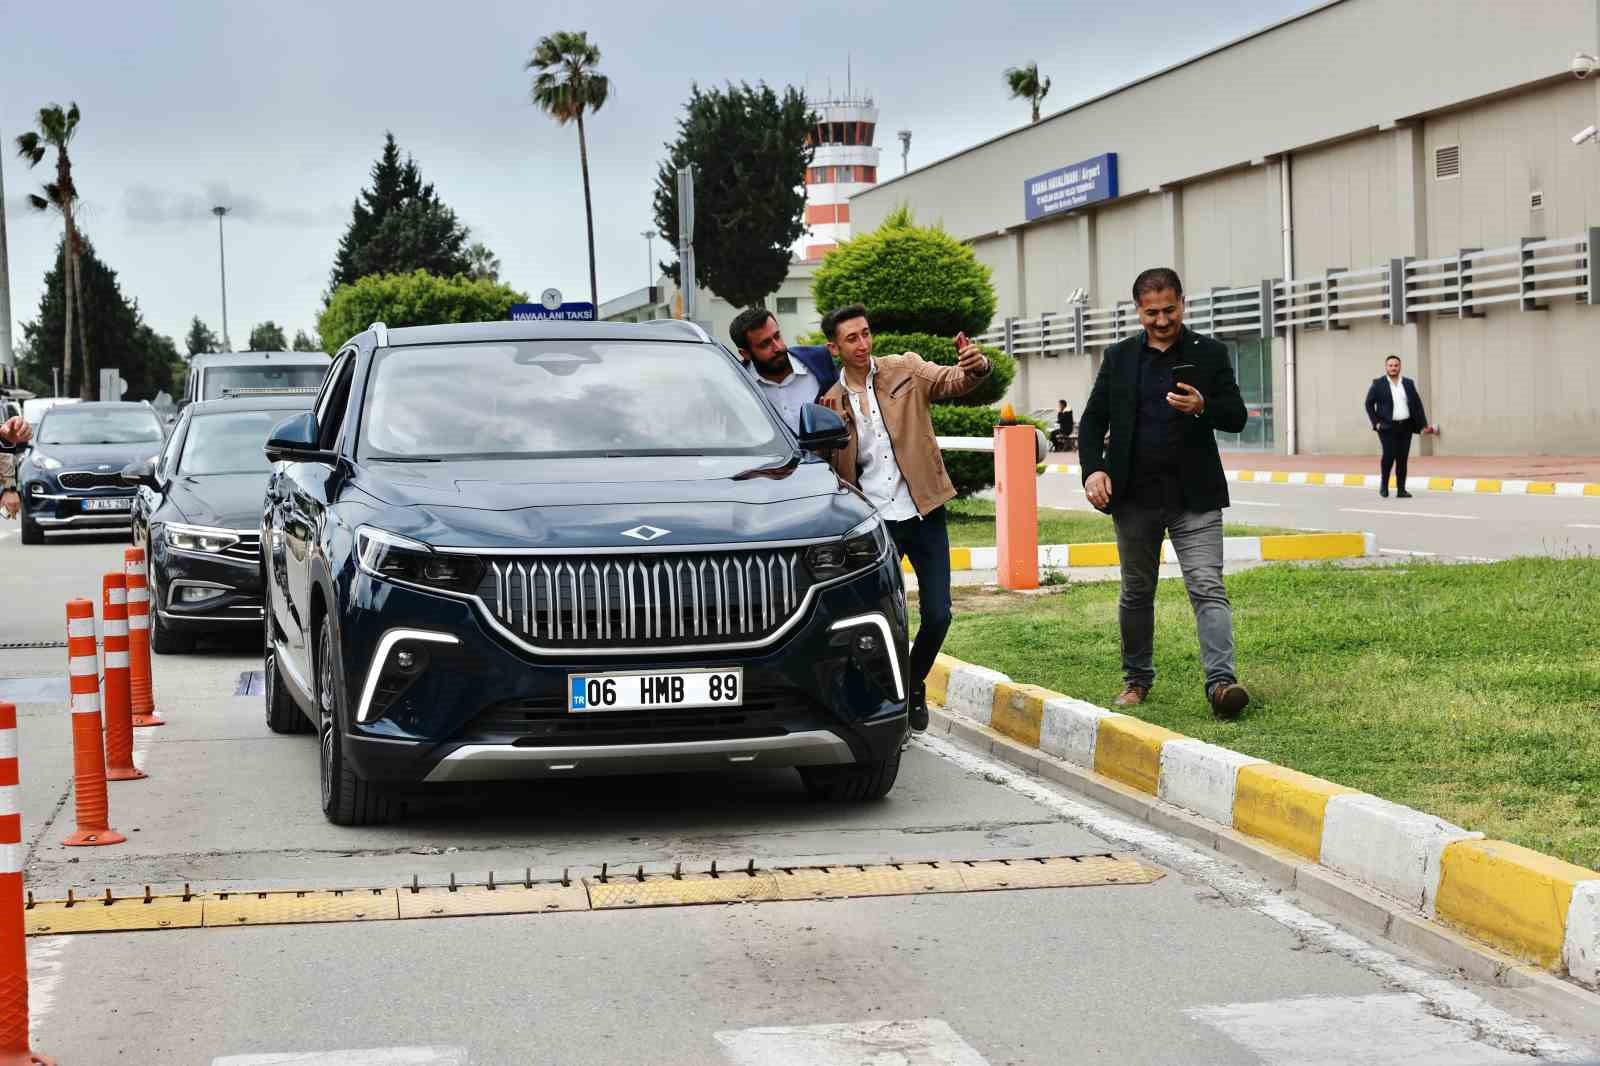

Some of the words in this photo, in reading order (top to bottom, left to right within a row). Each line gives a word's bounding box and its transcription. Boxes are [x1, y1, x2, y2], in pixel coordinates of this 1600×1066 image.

[513, 311, 565, 320] HAVAALANI
[574, 696, 585, 704] TR
[588, 679, 617, 706] 06
[640, 676, 684, 704] HMB
[709, 674, 737, 701] 89
